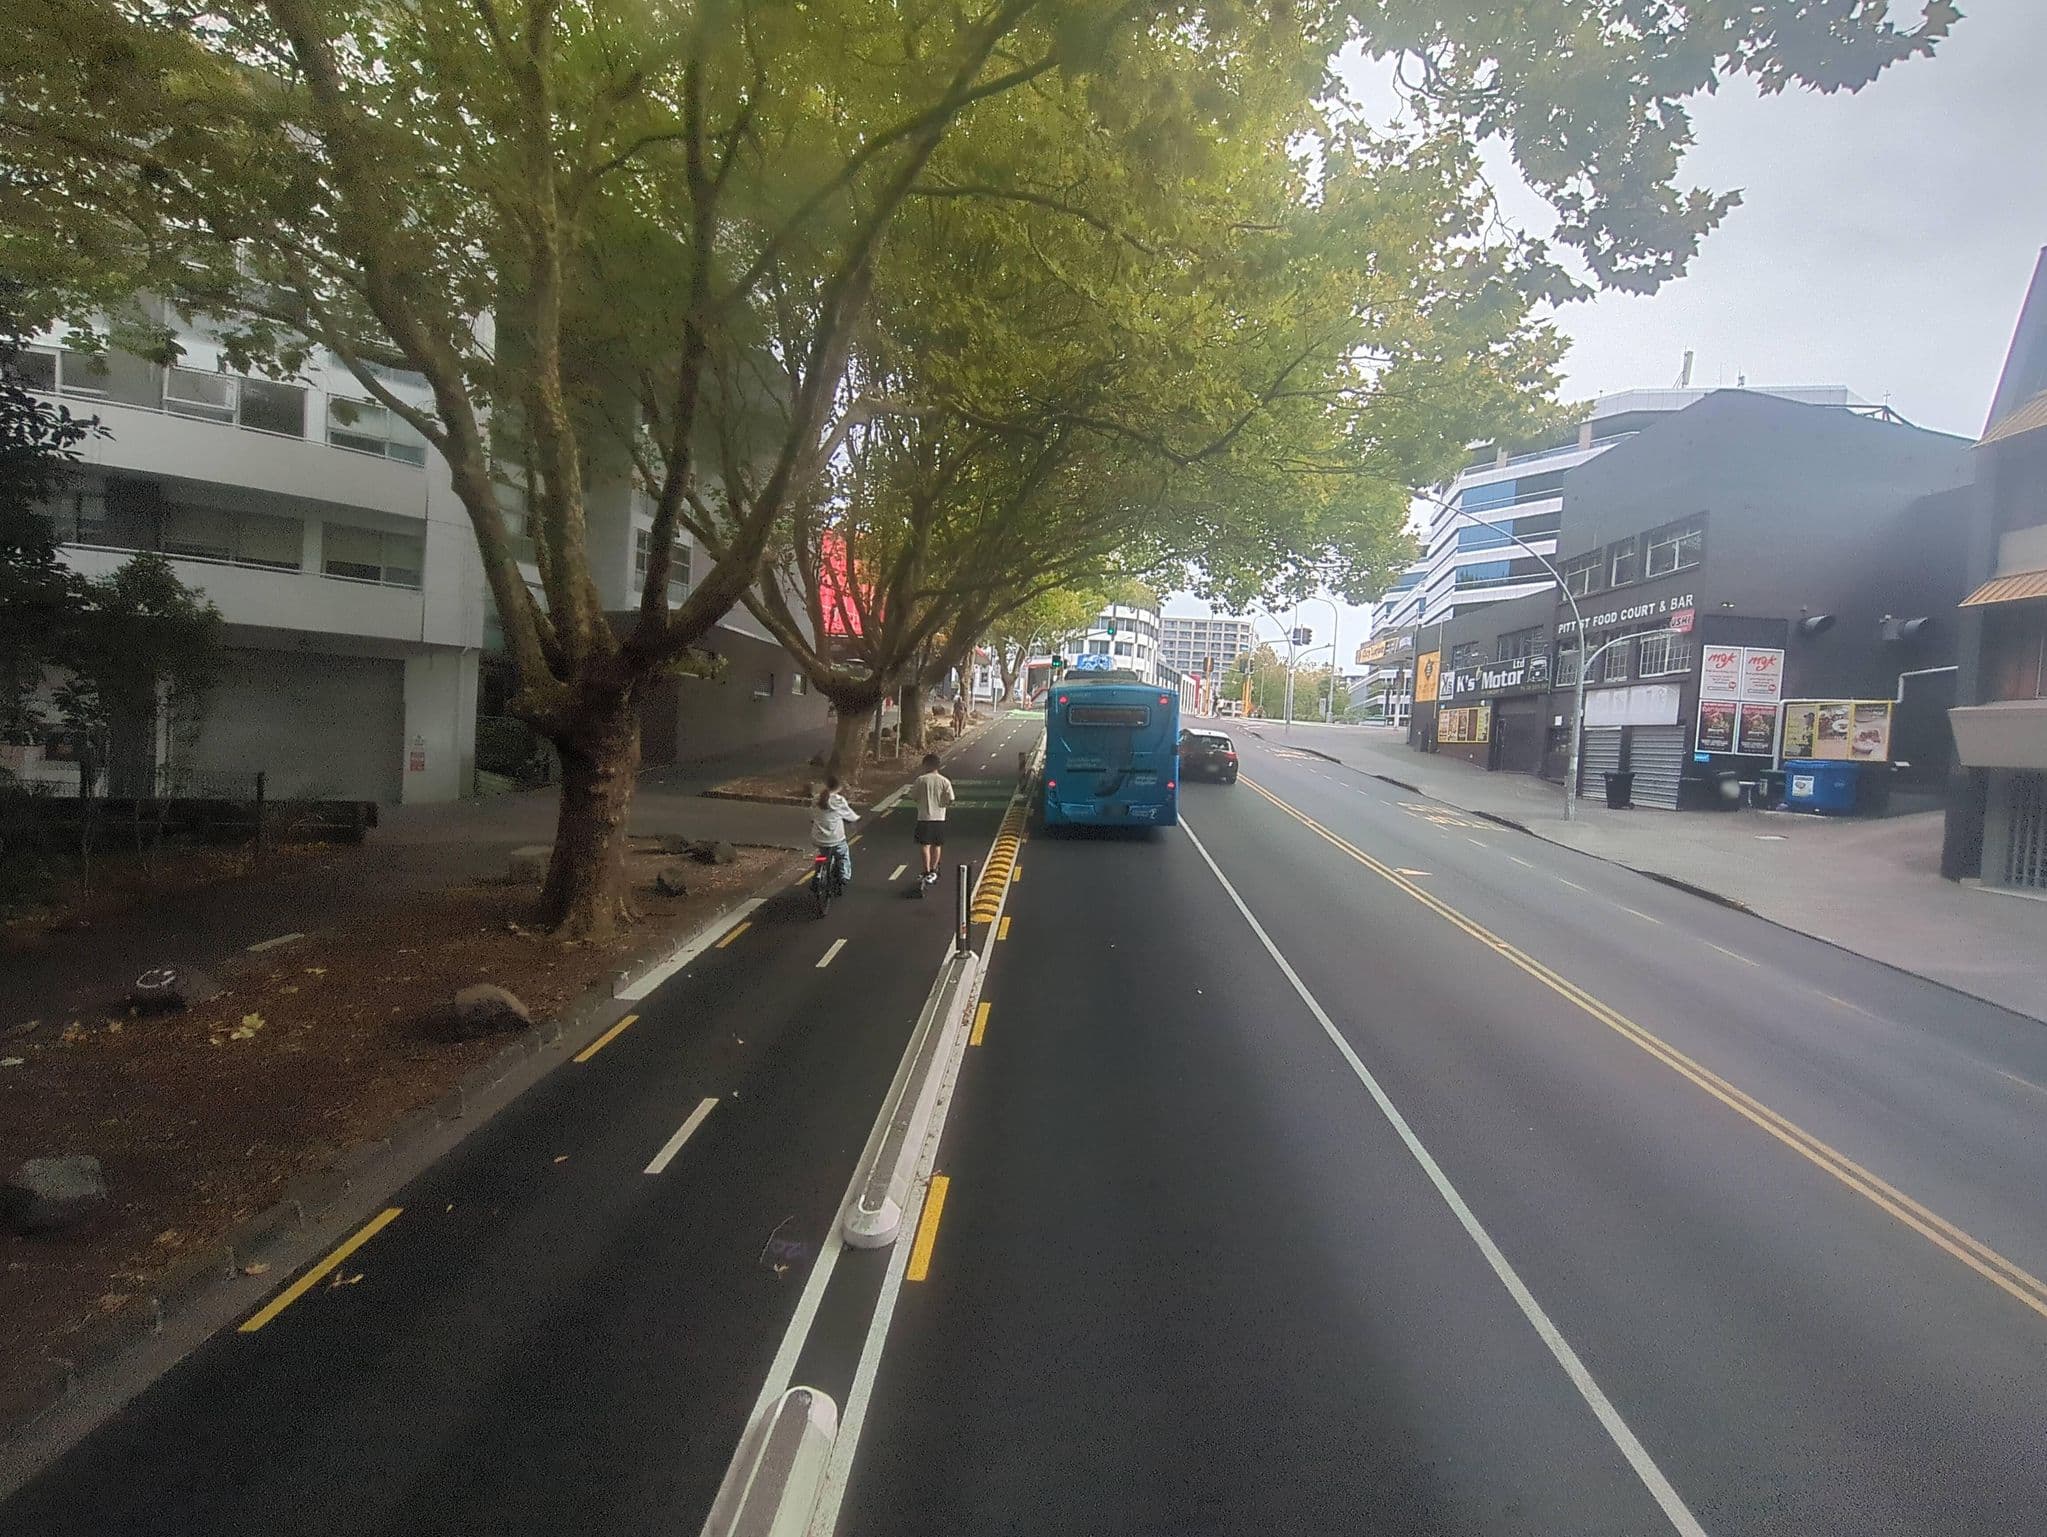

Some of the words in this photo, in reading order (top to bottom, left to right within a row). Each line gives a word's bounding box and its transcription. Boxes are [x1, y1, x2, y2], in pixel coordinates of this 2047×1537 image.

[1558, 620, 1577, 634] PITT
[1592, 612, 1618, 627] FOOD
[1620, 603, 1656, 621] COURT
[1659, 600, 1666, 613] &
[1670, 594, 1694, 610] BAR
[1456, 674, 1476, 693] K's
[1481, 669, 1525, 690] Motor
